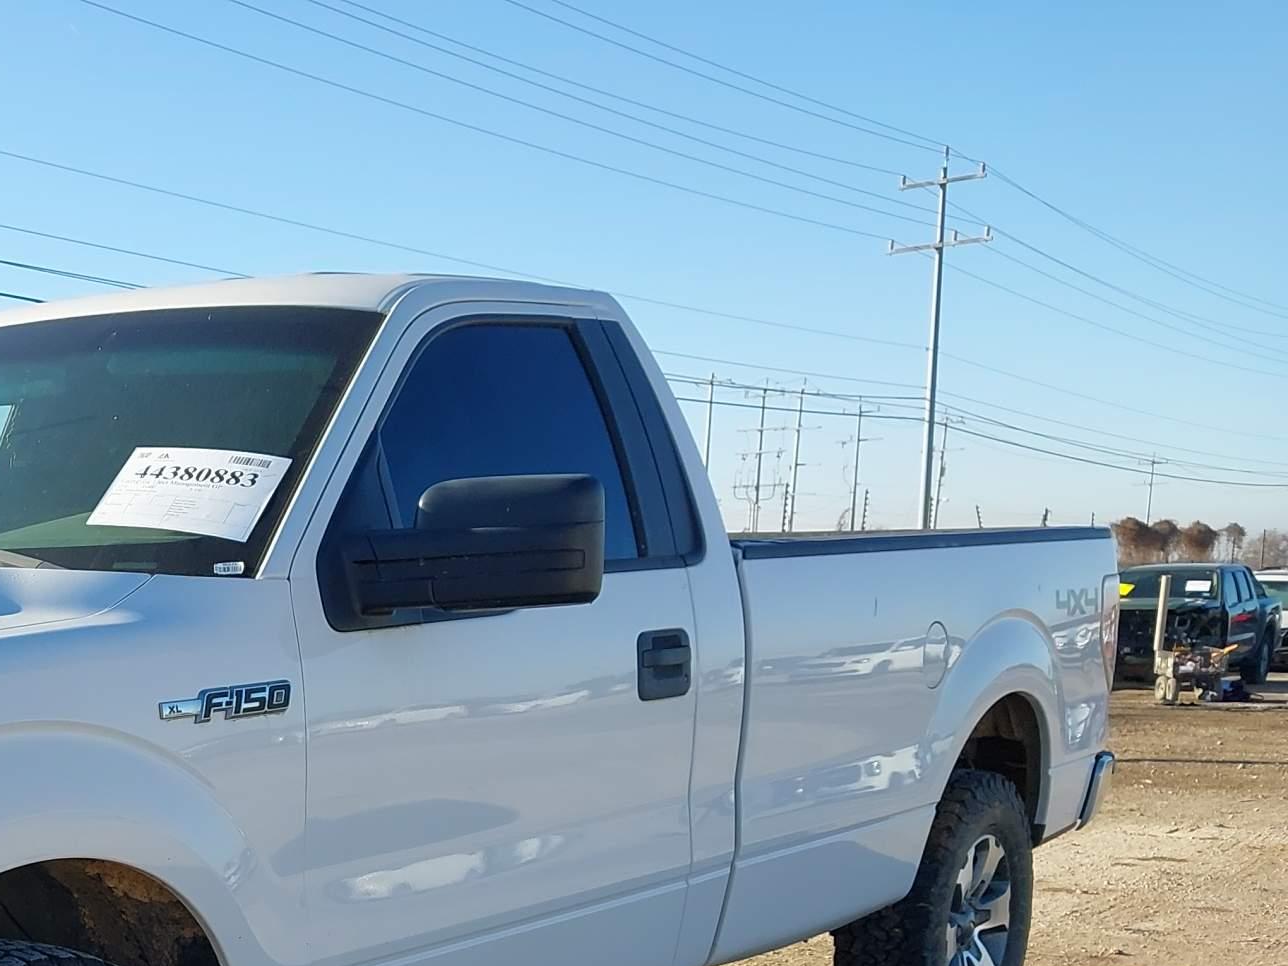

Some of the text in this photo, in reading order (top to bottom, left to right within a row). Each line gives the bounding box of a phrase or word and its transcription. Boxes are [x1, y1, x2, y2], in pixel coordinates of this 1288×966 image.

[135, 464, 260, 488] 44380883
[168, 681, 291, 721] XL F-150
